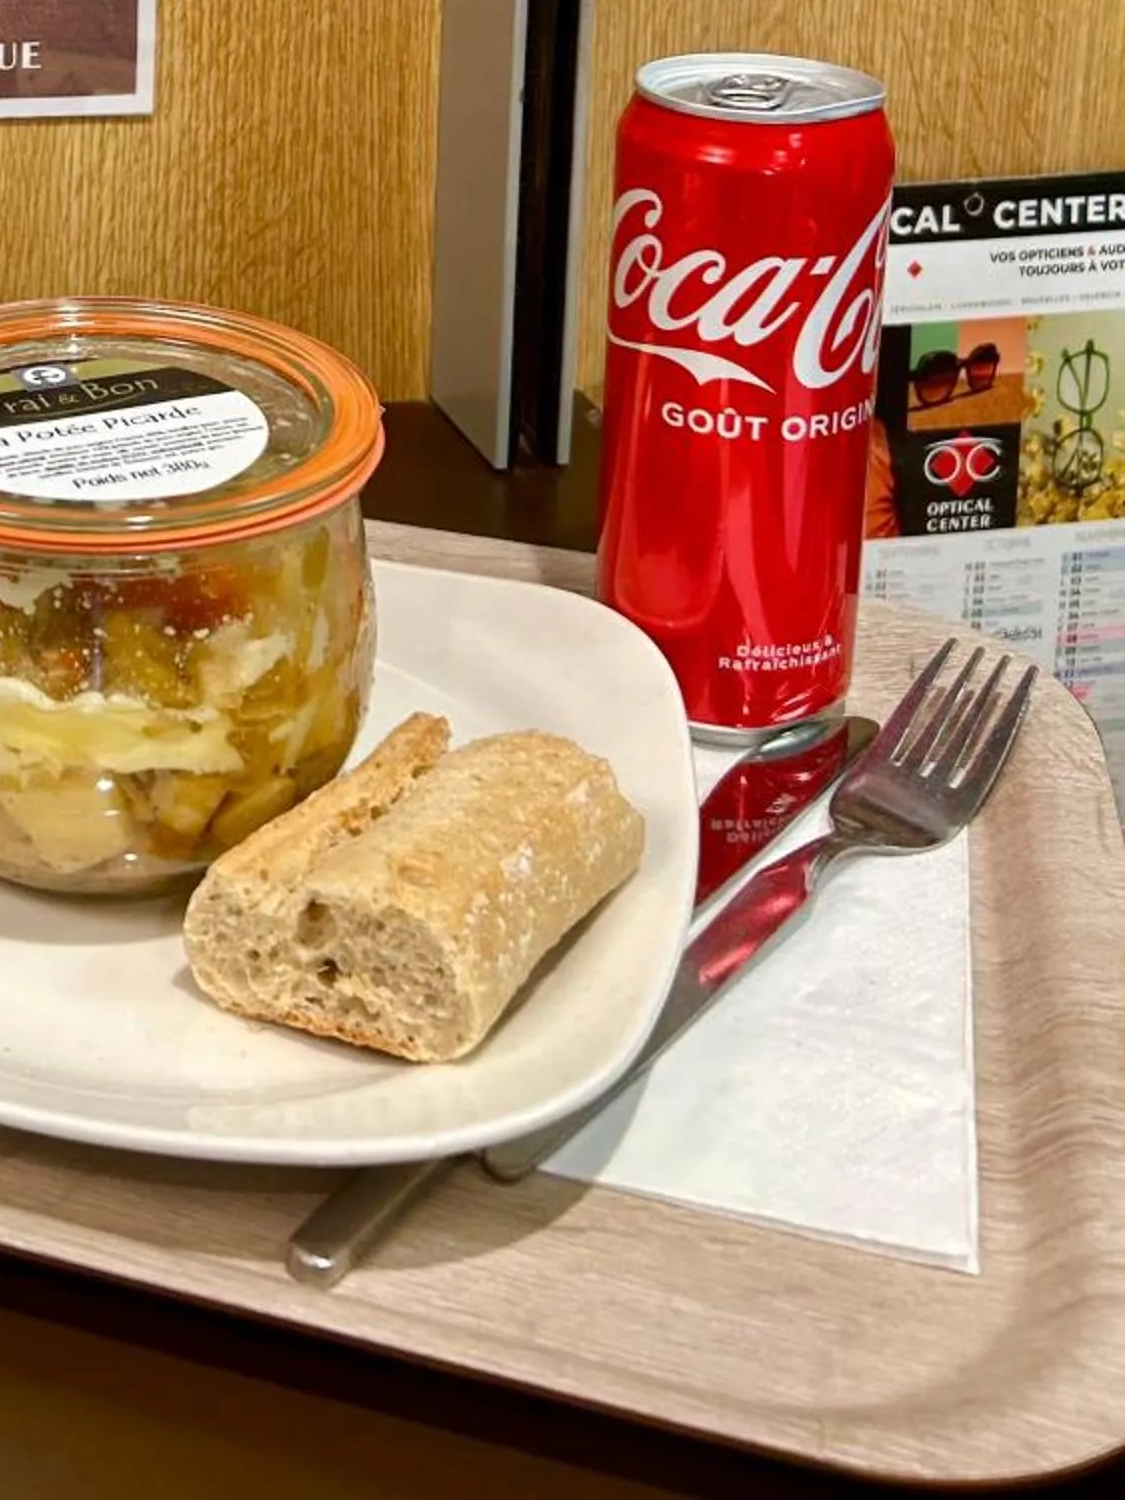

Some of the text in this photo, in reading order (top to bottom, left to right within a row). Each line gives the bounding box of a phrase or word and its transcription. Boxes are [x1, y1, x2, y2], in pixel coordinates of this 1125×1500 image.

[993, 192, 1125, 230] CENTER
[990, 251, 1015, 263] VOS
[1019, 246, 1084, 261] OPTICIENS
[1020, 262, 1084, 277] TOUJOURS
[59, 394, 79, 403] &
[81, 378, 158, 400] Bon
[17, 423, 97, 442] Potée
[104, 405, 202, 430] Picarde
[662, 401, 768, 441] GOÛT
[73, 471, 125, 489] Poids
[131, 466, 160, 481] net
[927, 498, 992, 516] OPTICAL
[927, 514, 992, 532] CENTER
[737, 642, 820, 657] Délicieux
